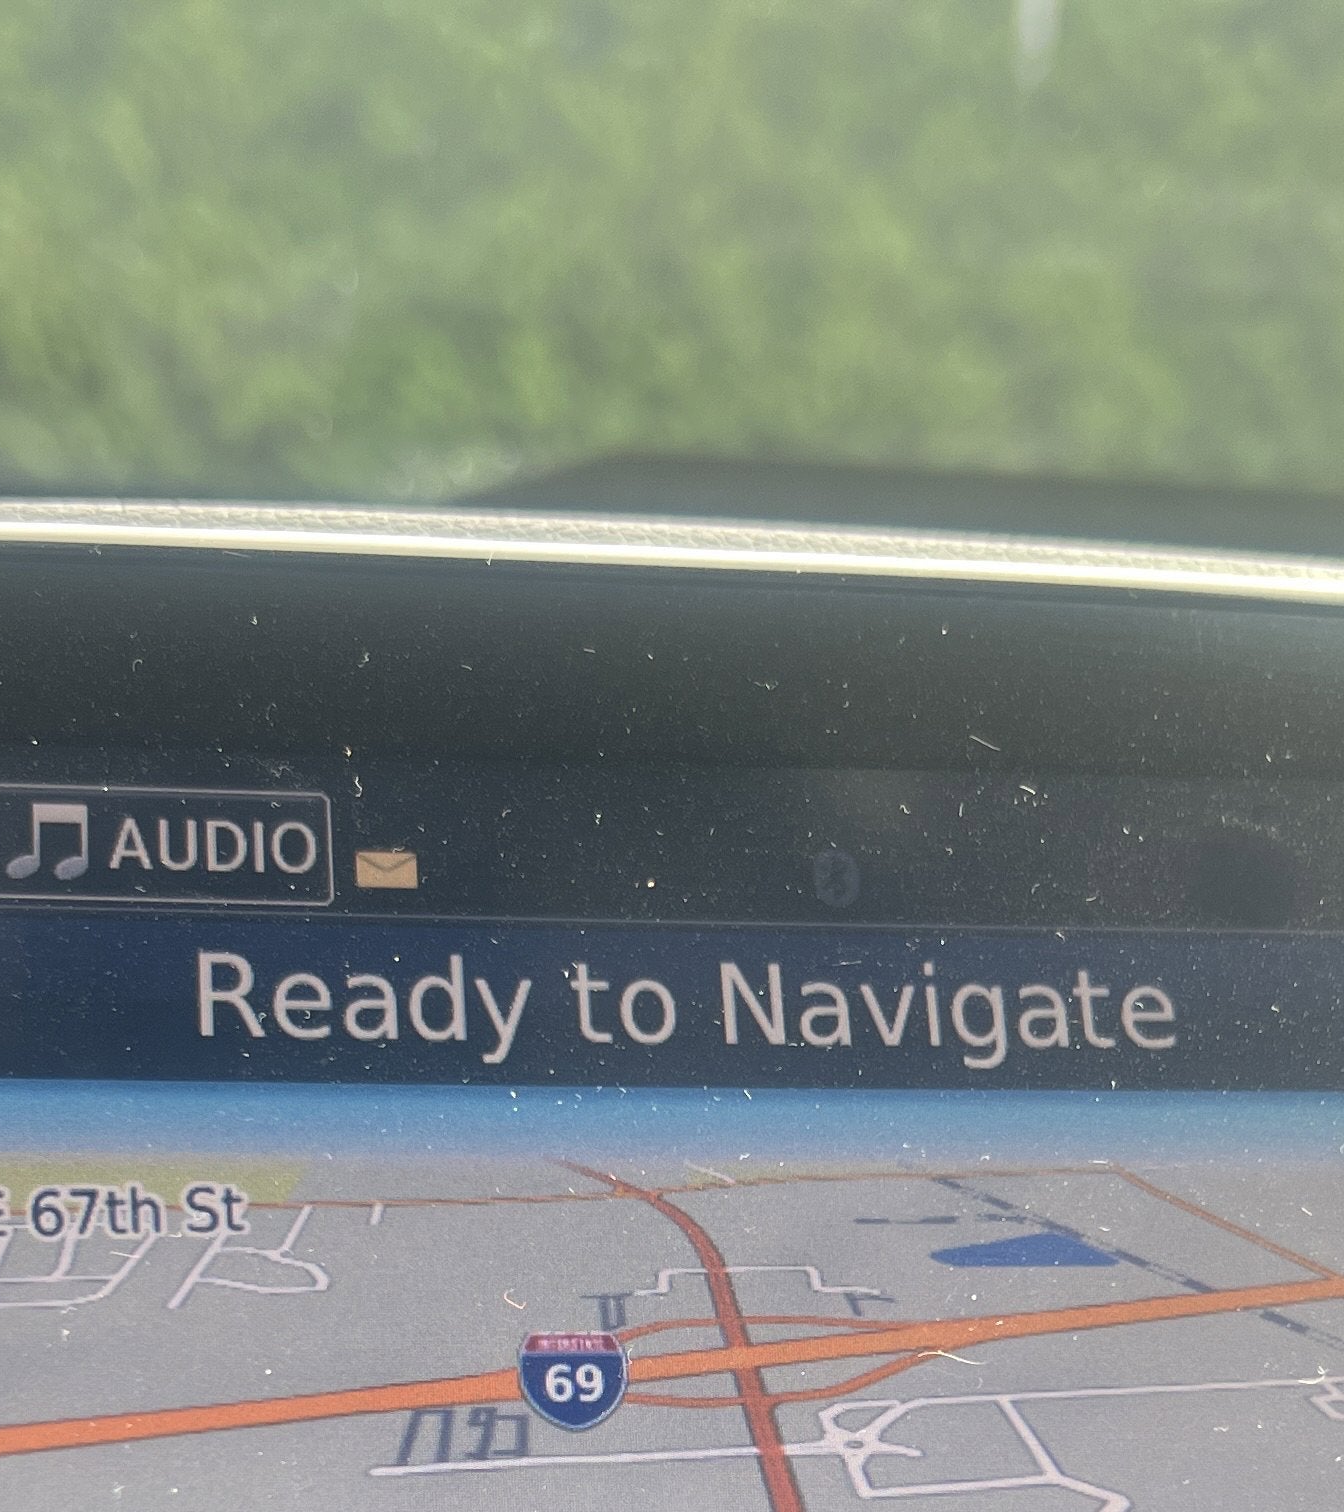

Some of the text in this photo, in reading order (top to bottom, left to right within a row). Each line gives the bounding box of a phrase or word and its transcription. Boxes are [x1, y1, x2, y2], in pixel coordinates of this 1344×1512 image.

[109, 817, 318, 876] AUDIO
[197, 951, 1178, 1070] Ready to Navigate
[30, 1185, 162, 1238] 67th
[186, 1185, 246, 1233] St
[545, 1363, 604, 1403] 69
